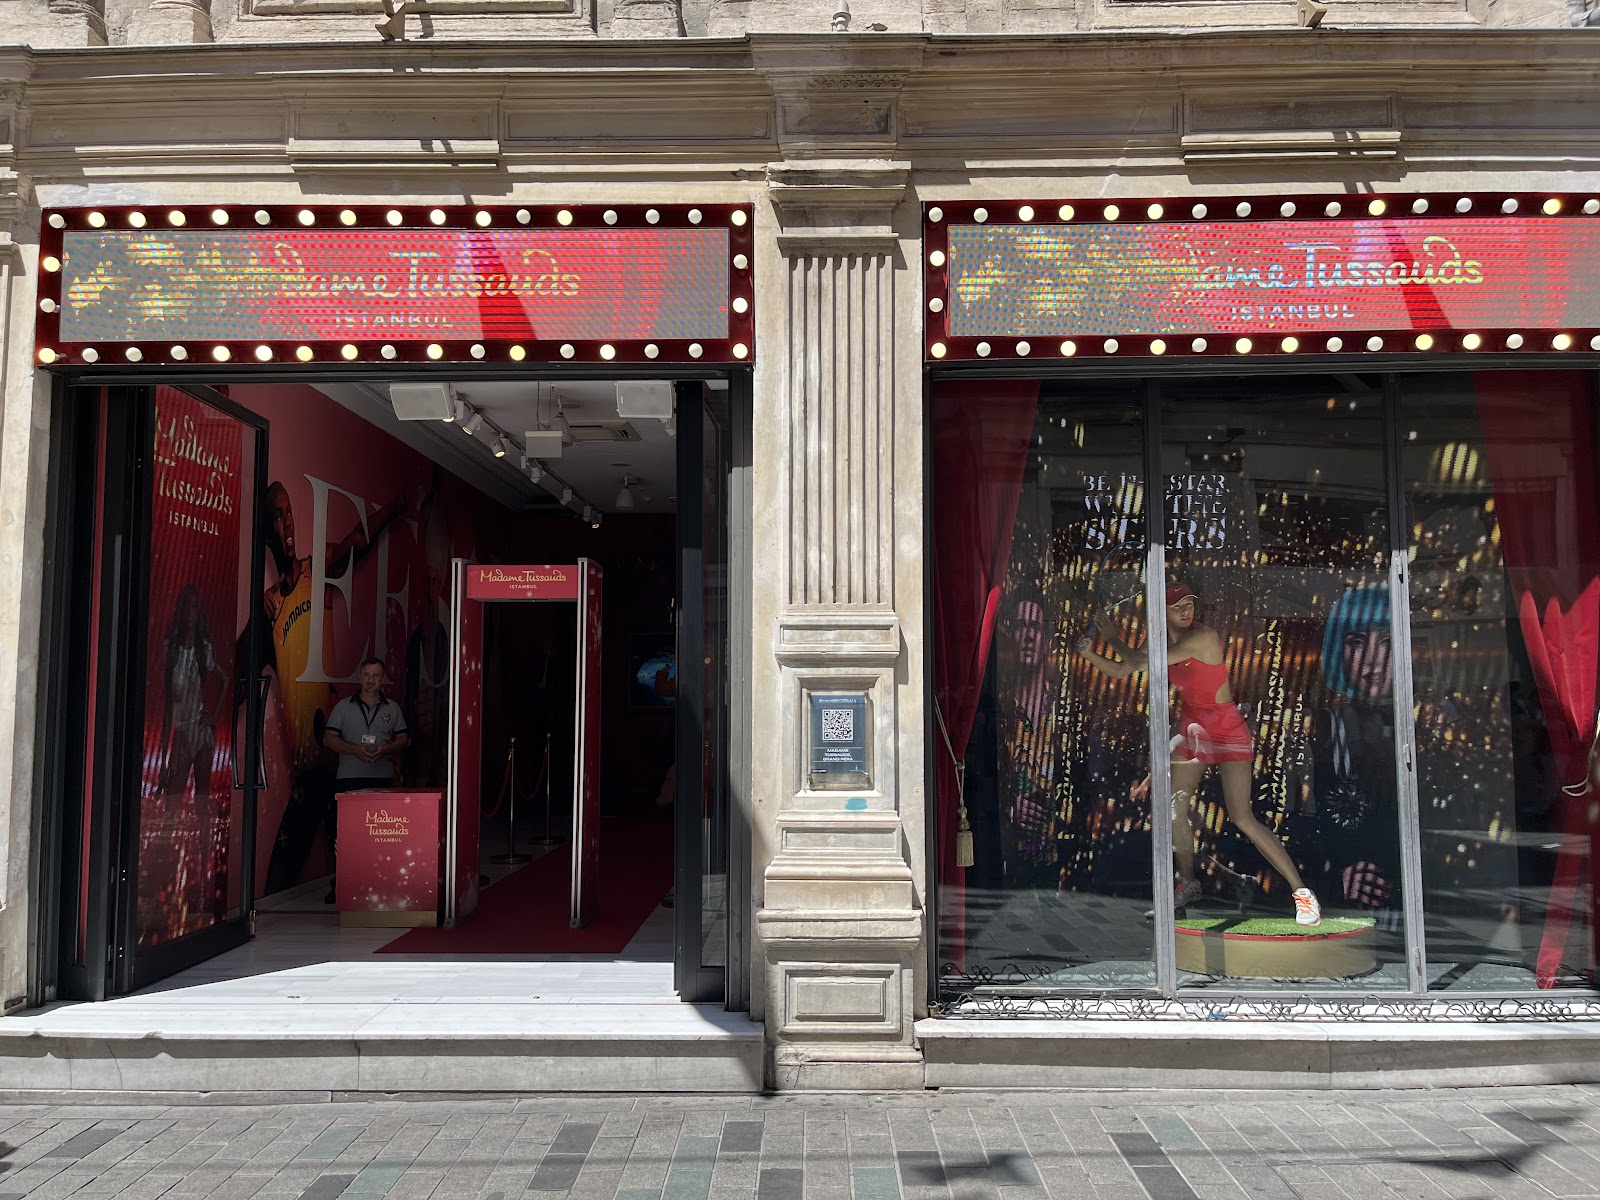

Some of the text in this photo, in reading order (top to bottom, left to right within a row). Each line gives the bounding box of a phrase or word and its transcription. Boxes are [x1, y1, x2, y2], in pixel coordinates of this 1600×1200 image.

[1283, 236, 1484, 289] Tussauds
[388, 249, 581, 298] Tussauds
[334, 311, 454, 328] ISTANBUL
[1231, 304, 1355, 321] ISTANBUL
[154, 454, 233, 515] Tussauds
[1168, 474, 1226, 492] STAR
[169, 510, 219, 536] ISTANBUL
[480, 568, 567, 583] Madame Tussauds
[282, 599, 312, 647] JAMAICA
[365, 809, 410, 824] Madame
[365, 823, 409, 836] Tussauds
